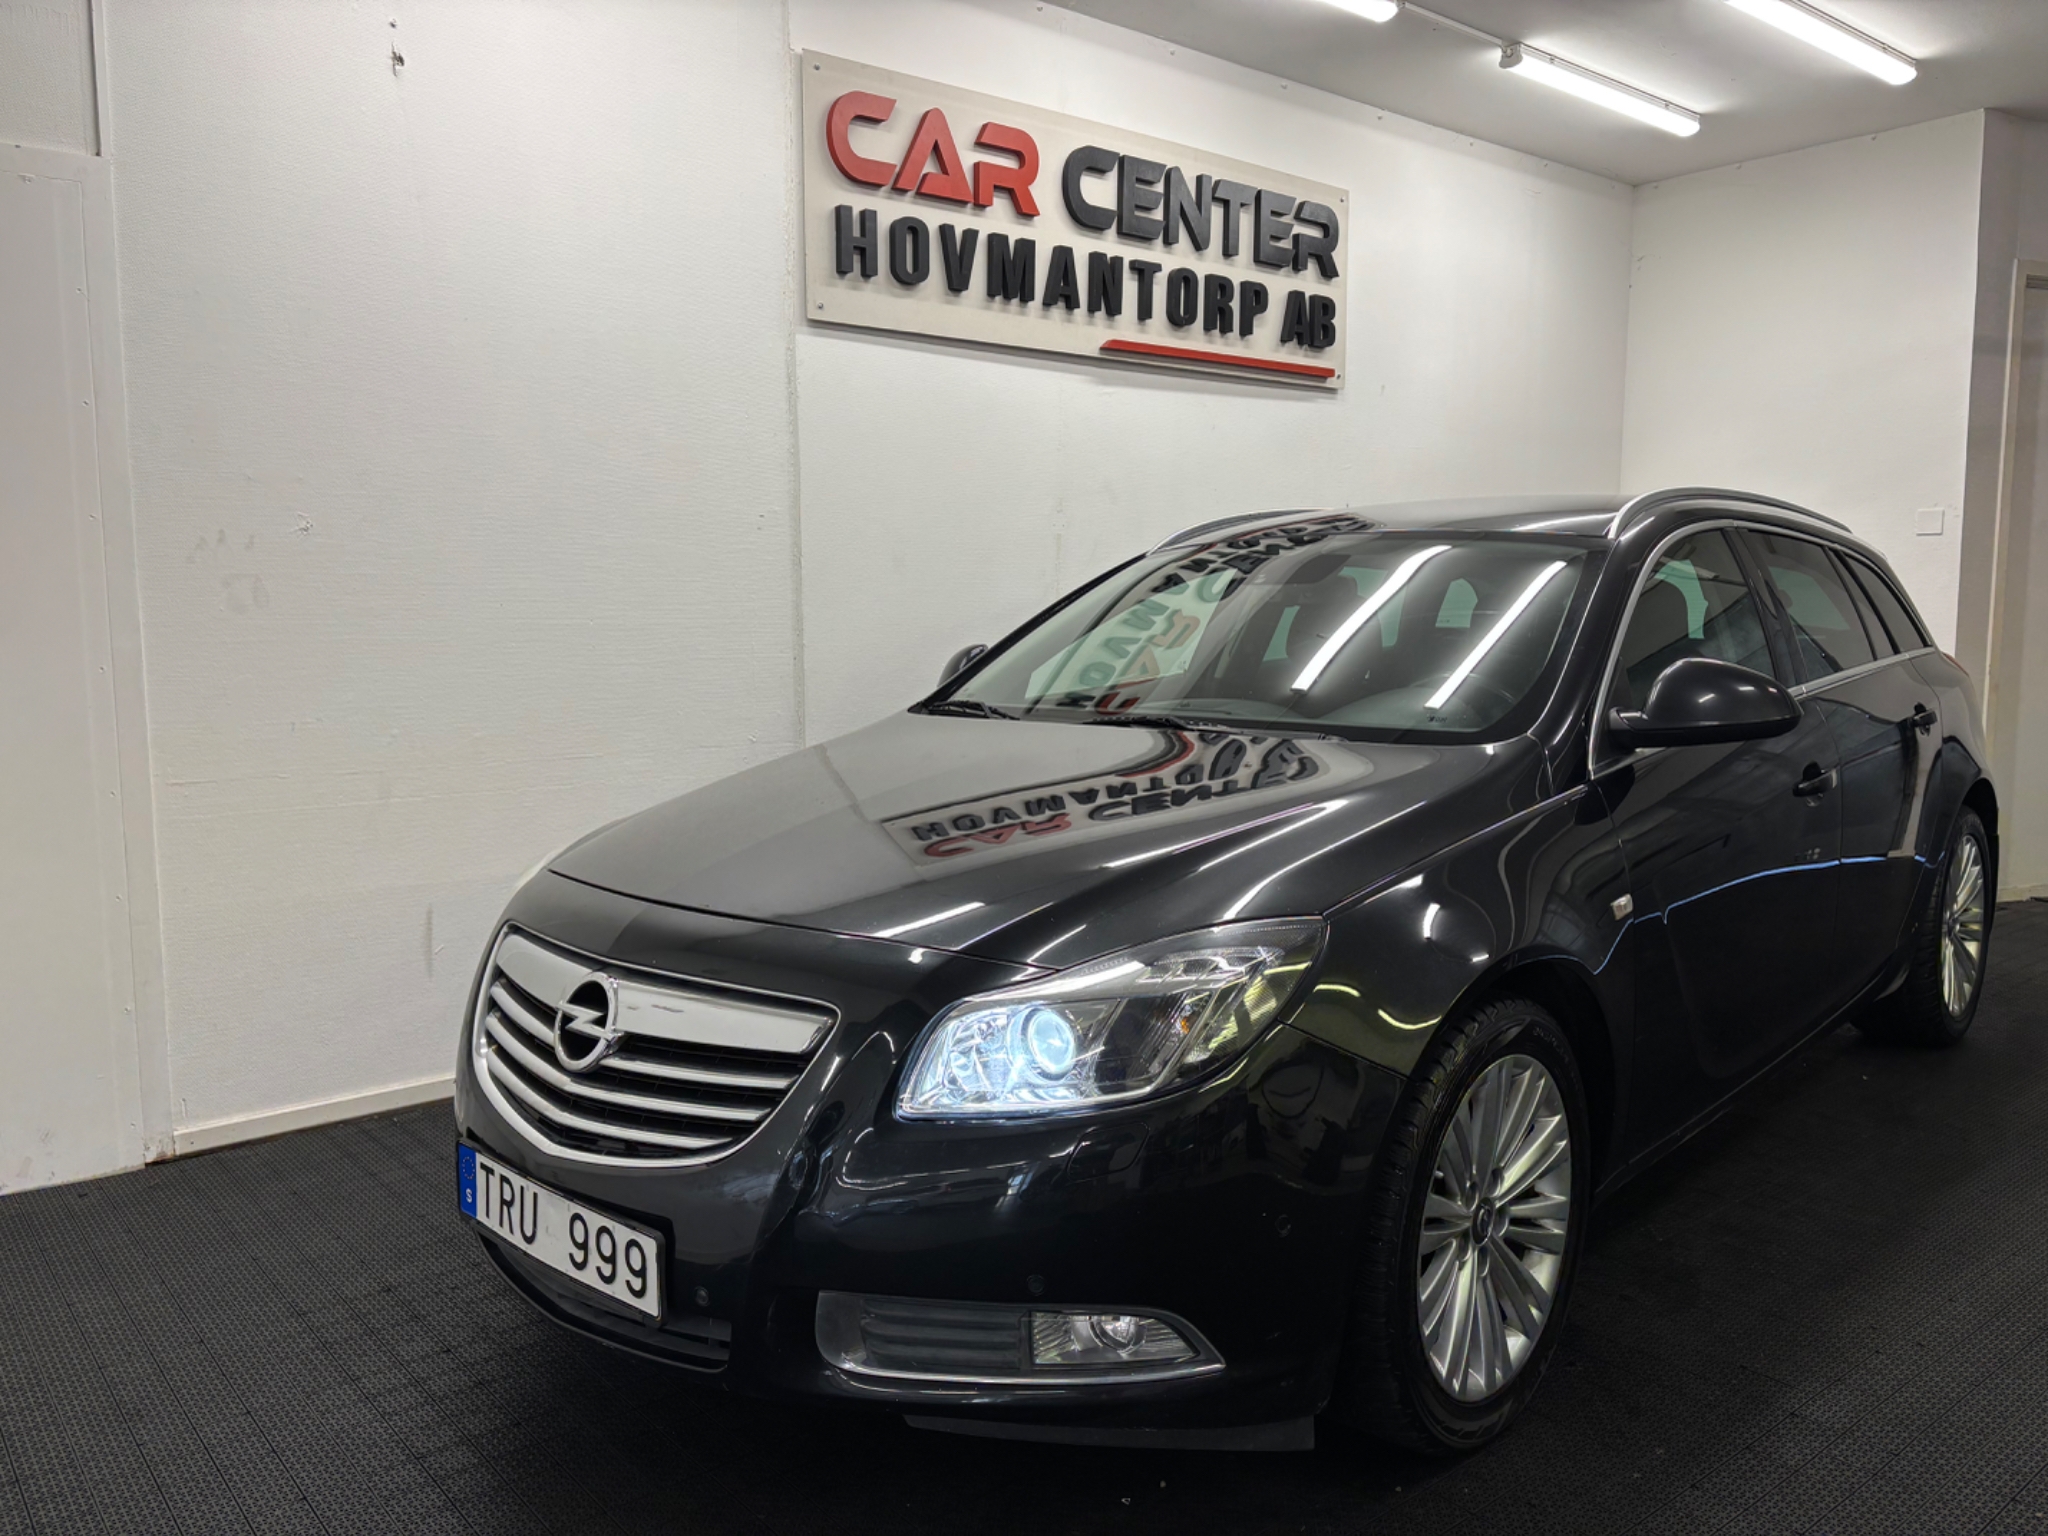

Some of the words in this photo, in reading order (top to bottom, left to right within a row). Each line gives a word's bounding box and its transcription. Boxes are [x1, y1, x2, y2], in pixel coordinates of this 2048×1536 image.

[826, 90, 1040, 218] CAR
[1062, 145, 1340, 280] CENTER
[834, 204, 1269, 337] HOVMANTORP
[1281, 290, 1336, 349] AB
[480, 1162, 538, 1245] TRU
[568, 1212, 647, 1299] 999
